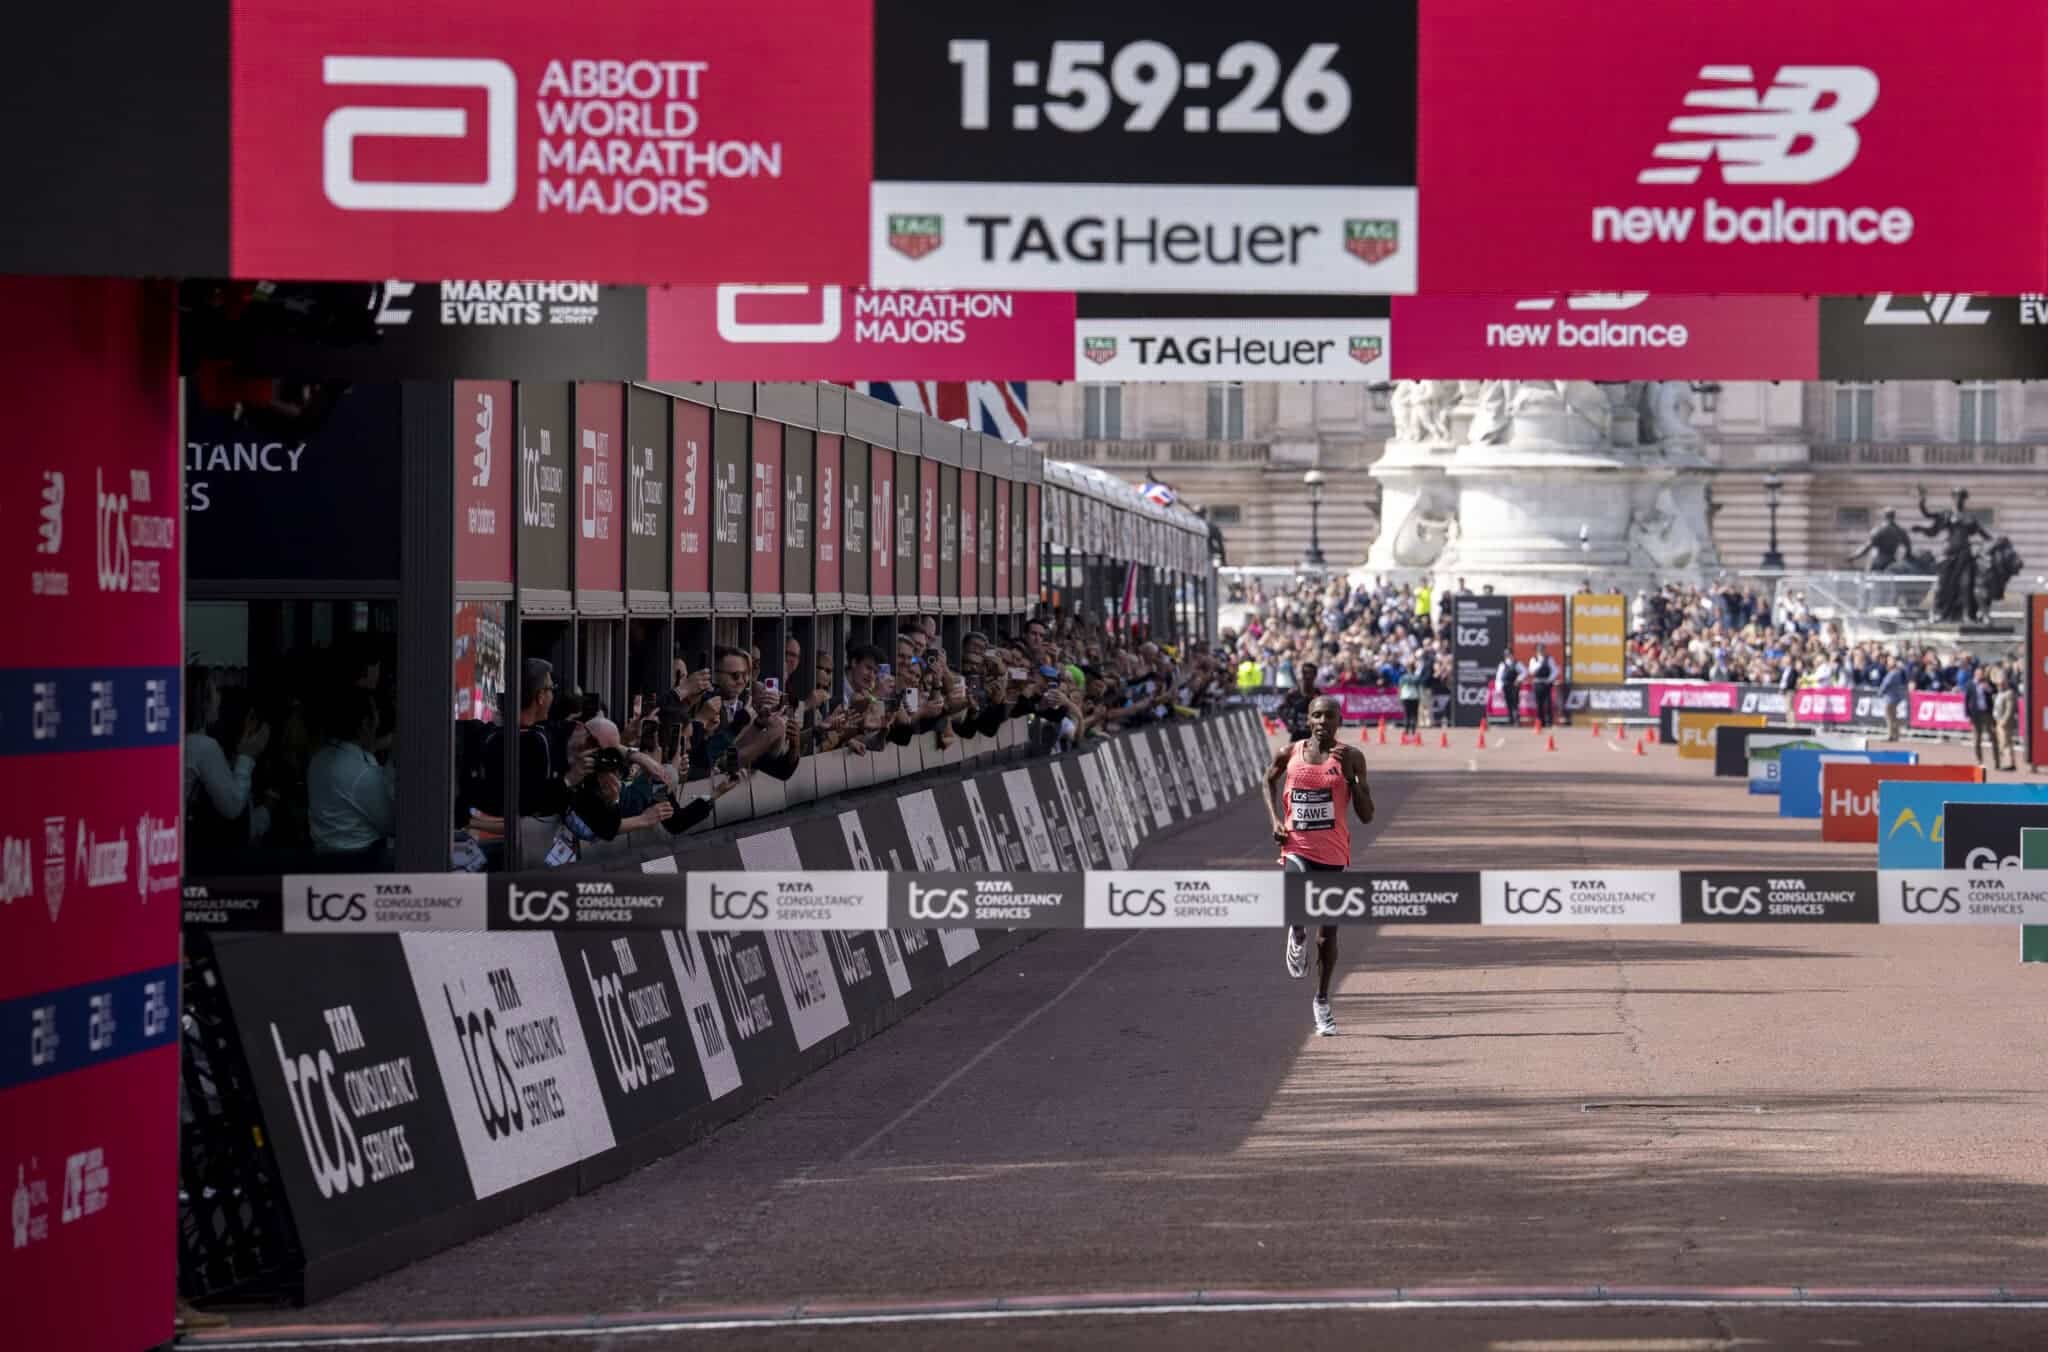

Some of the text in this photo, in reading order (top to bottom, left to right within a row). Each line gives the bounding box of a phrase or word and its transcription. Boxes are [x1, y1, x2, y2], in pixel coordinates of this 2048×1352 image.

[539, 60, 707, 99] ABBOTT
[949, 40, 1351, 134] 1:59:26
[537, 101, 698, 137] WORLD
[539, 140, 780, 180] MARATHON
[538, 179, 708, 215] MAJORS
[1592, 199, 1913, 243] new balance
[440, 280, 598, 302] MARATHON
[440, 301, 541, 326] EVENTS
[856, 295, 1012, 317] MARATHON
[856, 320, 965, 343] MAJORS
[1487, 319, 1688, 347] new balance
[1296, 807, 1329, 819] SAWE
[376, 885, 411, 894] TATA
[576, 883, 614, 894] TATA
[778, 883, 813, 892] TATA
[976, 881, 1013, 892] TATA
[1175, 882, 1210, 890] TATA
[1372, 880, 1409, 894] TATA
[1571, 881, 1606, 889] TATA
[1768, 880, 1805, 890] TATA
[1968, 880, 2004, 888] TATA
[307, 886, 366, 921] tcs
[374, 897, 462, 908] CONSULTANCY
[509, 884, 569, 921] tcs
[576, 896, 664, 911] CONSULTANCY
[711, 883, 768, 920] tcs
[776, 896, 862, 906] CONSULTANCY
[909, 882, 969, 919] tcs
[975, 894, 1062, 906] CONSULTANCY
[1109, 882, 1166, 916] tcs
[1174, 894, 1258, 904] CONSULTANCY
[1305, 880, 1365, 916] tcs
[1372, 893, 1458, 907] CONSULTANCY
[1505, 882, 1562, 914] tcs
[1570, 892, 1656, 902] CONSULTANCY
[1702, 880, 1762, 914] tcs
[1768, 891, 1855, 906] CONSULTANCY
[1902, 880, 1960, 914] tcs
[375, 911, 431, 922] SERVICES
[576, 909, 632, 921] SERVICES
[776, 909, 831, 920] SERVICES
[975, 904, 1031, 919] SERVICES
[1174, 906, 1228, 917] SERVICES
[1372, 902, 1427, 916] SERVICES
[1570, 904, 1624, 914] SERVICES
[1769, 904, 1824, 914] SERVICES
[1969, 904, 2024, 914] SERVICES
[487, 967, 522, 1012] TATA
[323, 1004, 366, 1054] TATA
[580, 949, 649, 1094] tcs
[442, 982, 524, 1142] tcs
[270, 1022, 365, 1199] tcs
[521, 1076, 566, 1128] SERVICES
[362, 1124, 415, 1182] SERVICES
